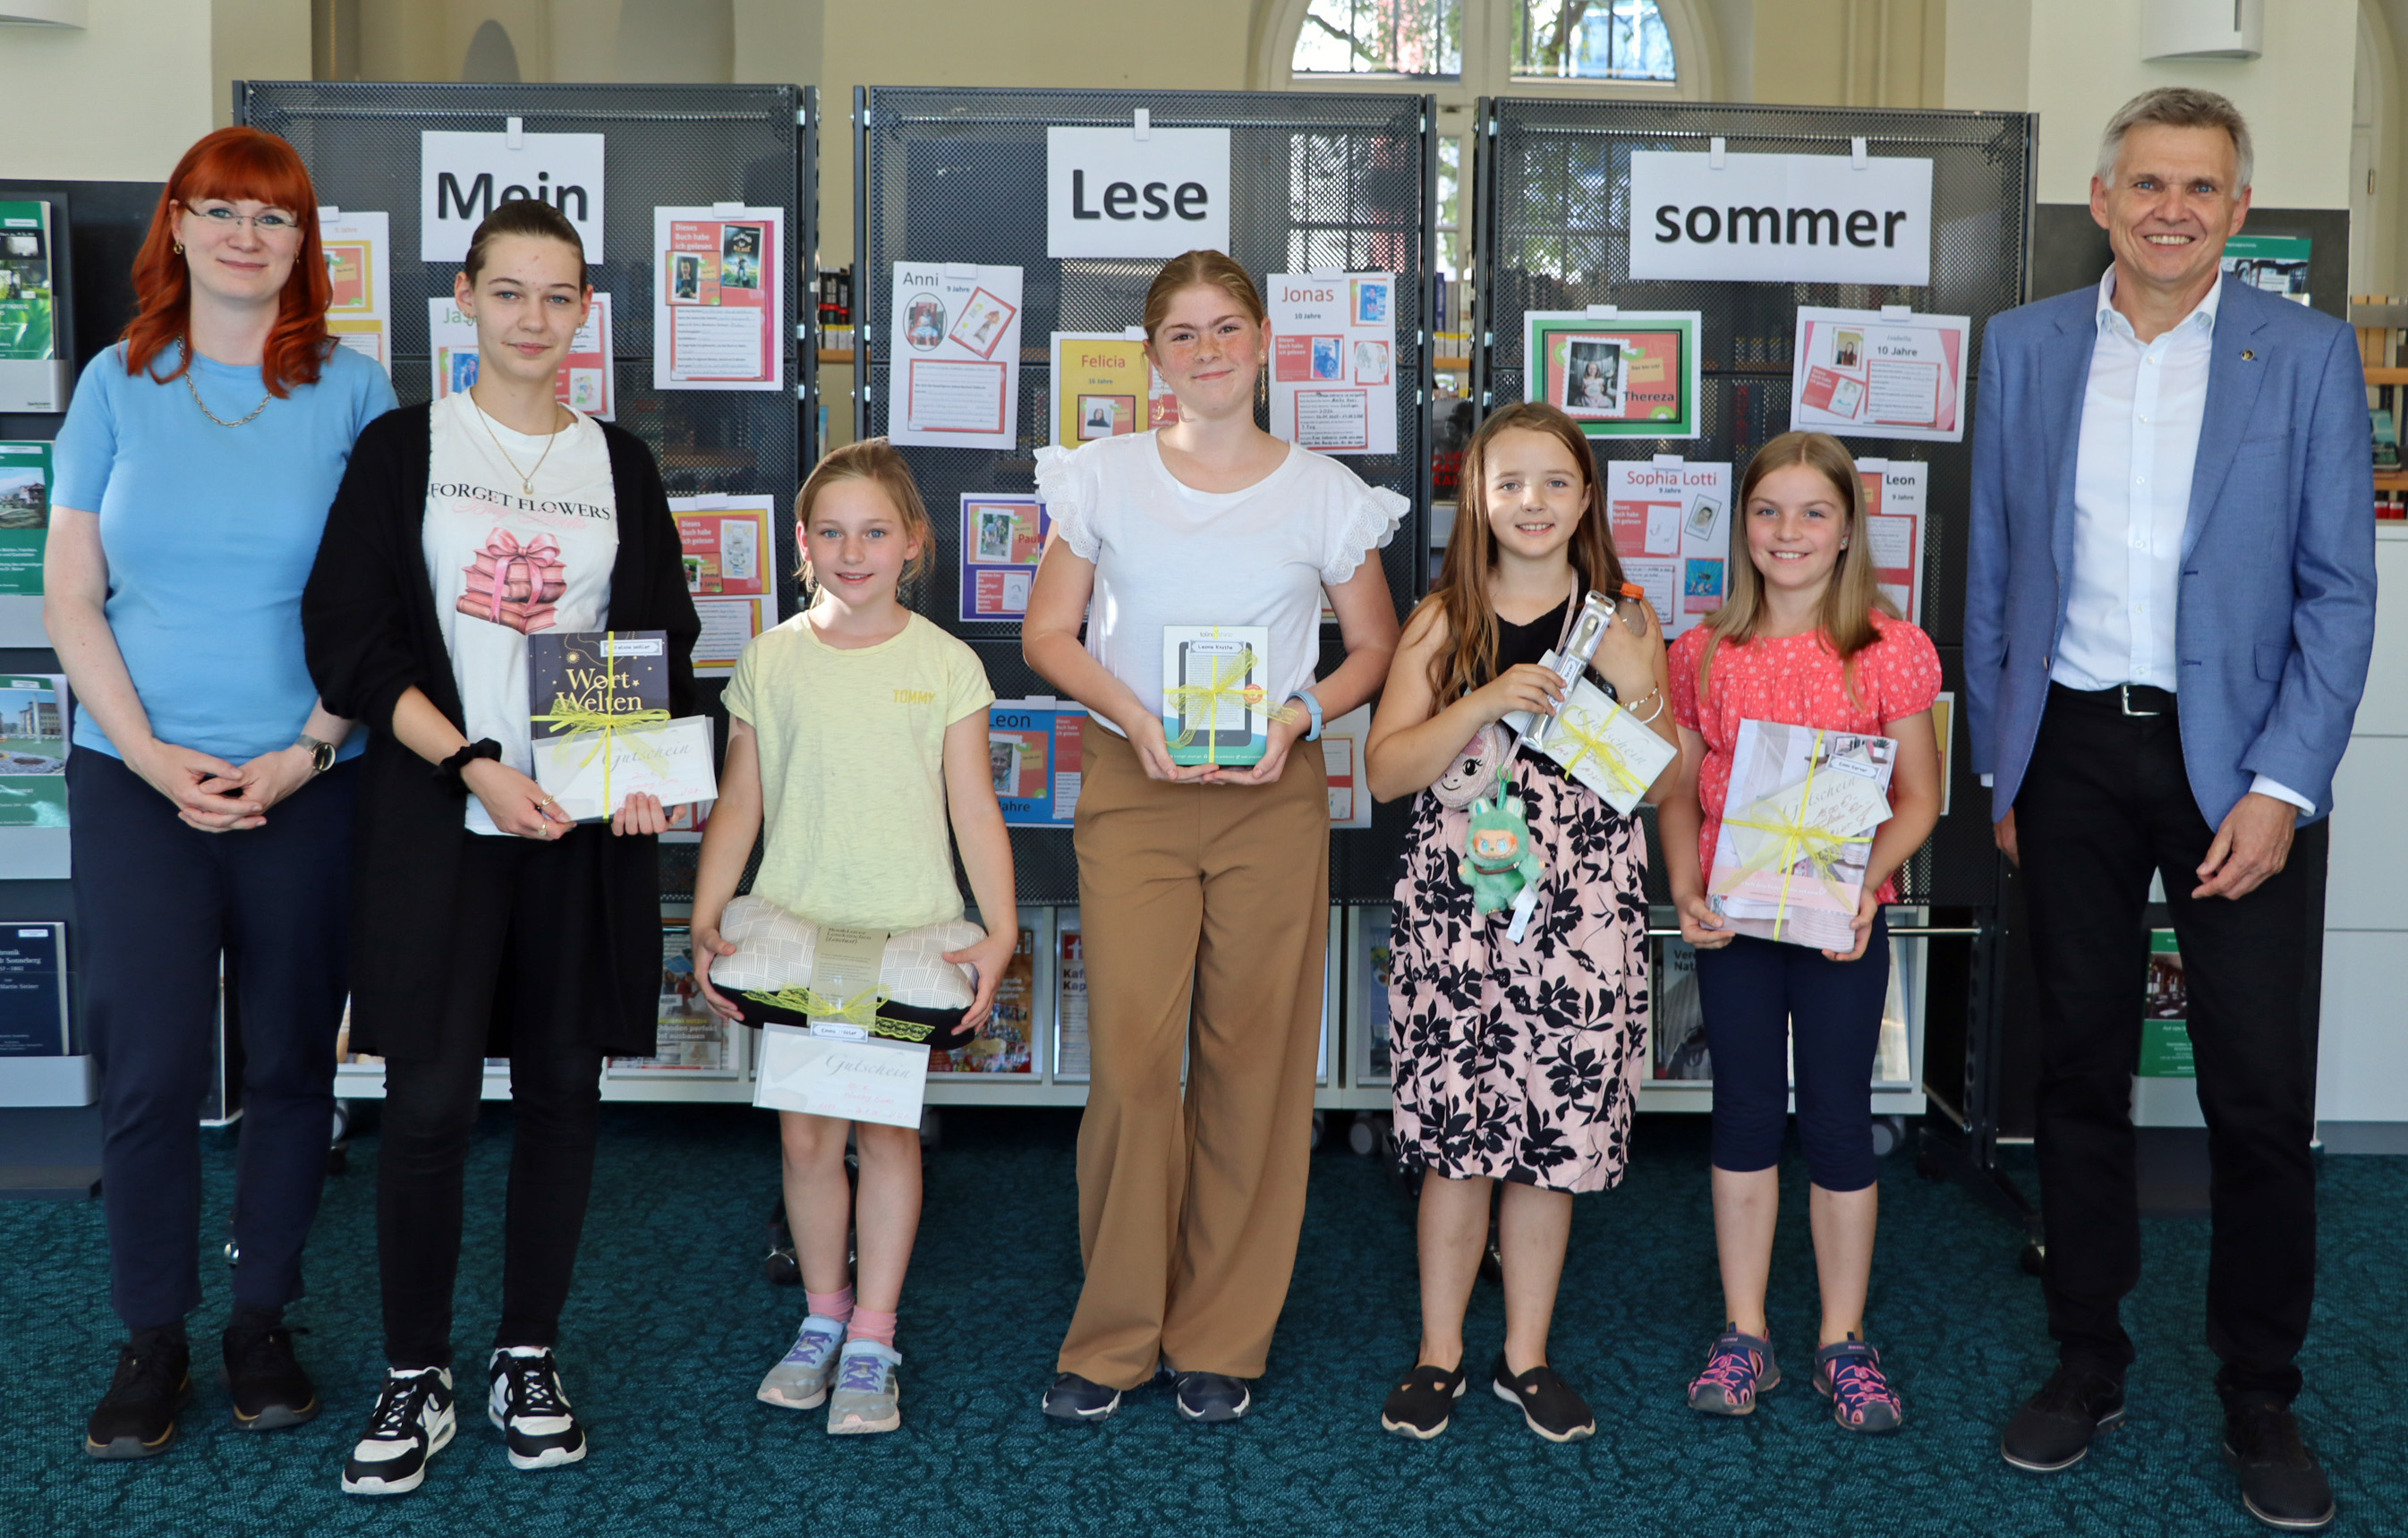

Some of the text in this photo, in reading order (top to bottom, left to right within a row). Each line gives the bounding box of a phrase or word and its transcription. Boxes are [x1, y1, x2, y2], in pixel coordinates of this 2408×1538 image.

[1073, 169, 1208, 220] Lese
[1655, 204, 1907, 248] sommer
[903, 272, 939, 287] Anni
[1281, 286, 1335, 303] Jonas
[1877, 346, 1918, 357] 10 Jahre
[1081, 354, 1126, 368] Felicia
[1623, 391, 1675, 402] Thereza
[1627, 471, 1718, 487] Sophia Lotti
[1886, 475, 1915, 485] Leon
[430, 483, 610, 521] FORGET FLOWERS
[566, 668, 631, 690] Wort
[556, 691, 643, 712] Welten
[893, 689, 936, 705] TOMMY
[1783, 777, 1855, 822] Gtschein
[825, 1053, 912, 1079] Gutschein
